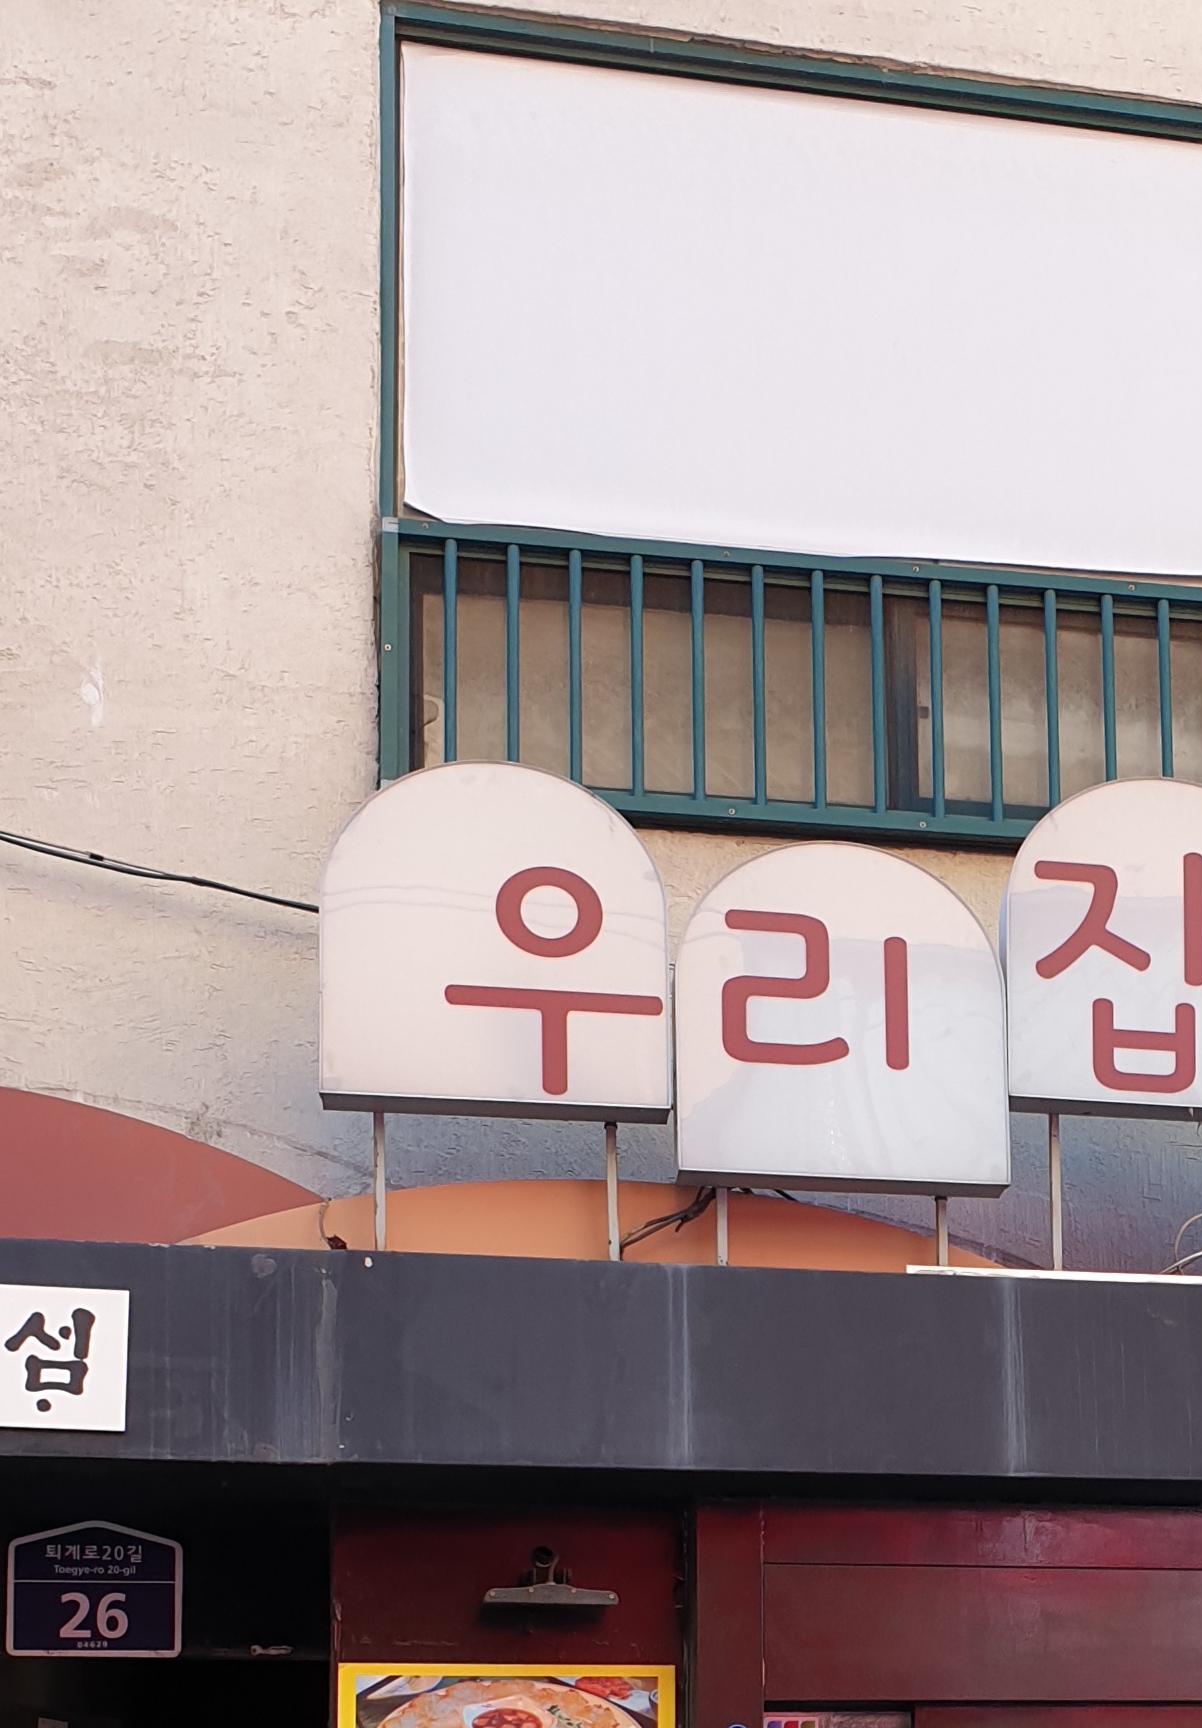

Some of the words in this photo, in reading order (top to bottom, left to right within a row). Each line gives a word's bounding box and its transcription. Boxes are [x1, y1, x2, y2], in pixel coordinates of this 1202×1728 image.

[45, 1544, 143, 1563] 퇴계로20길
[107, 1564, 136, 1575] 20-gil
[59, 1592, 129, 1639] 26
